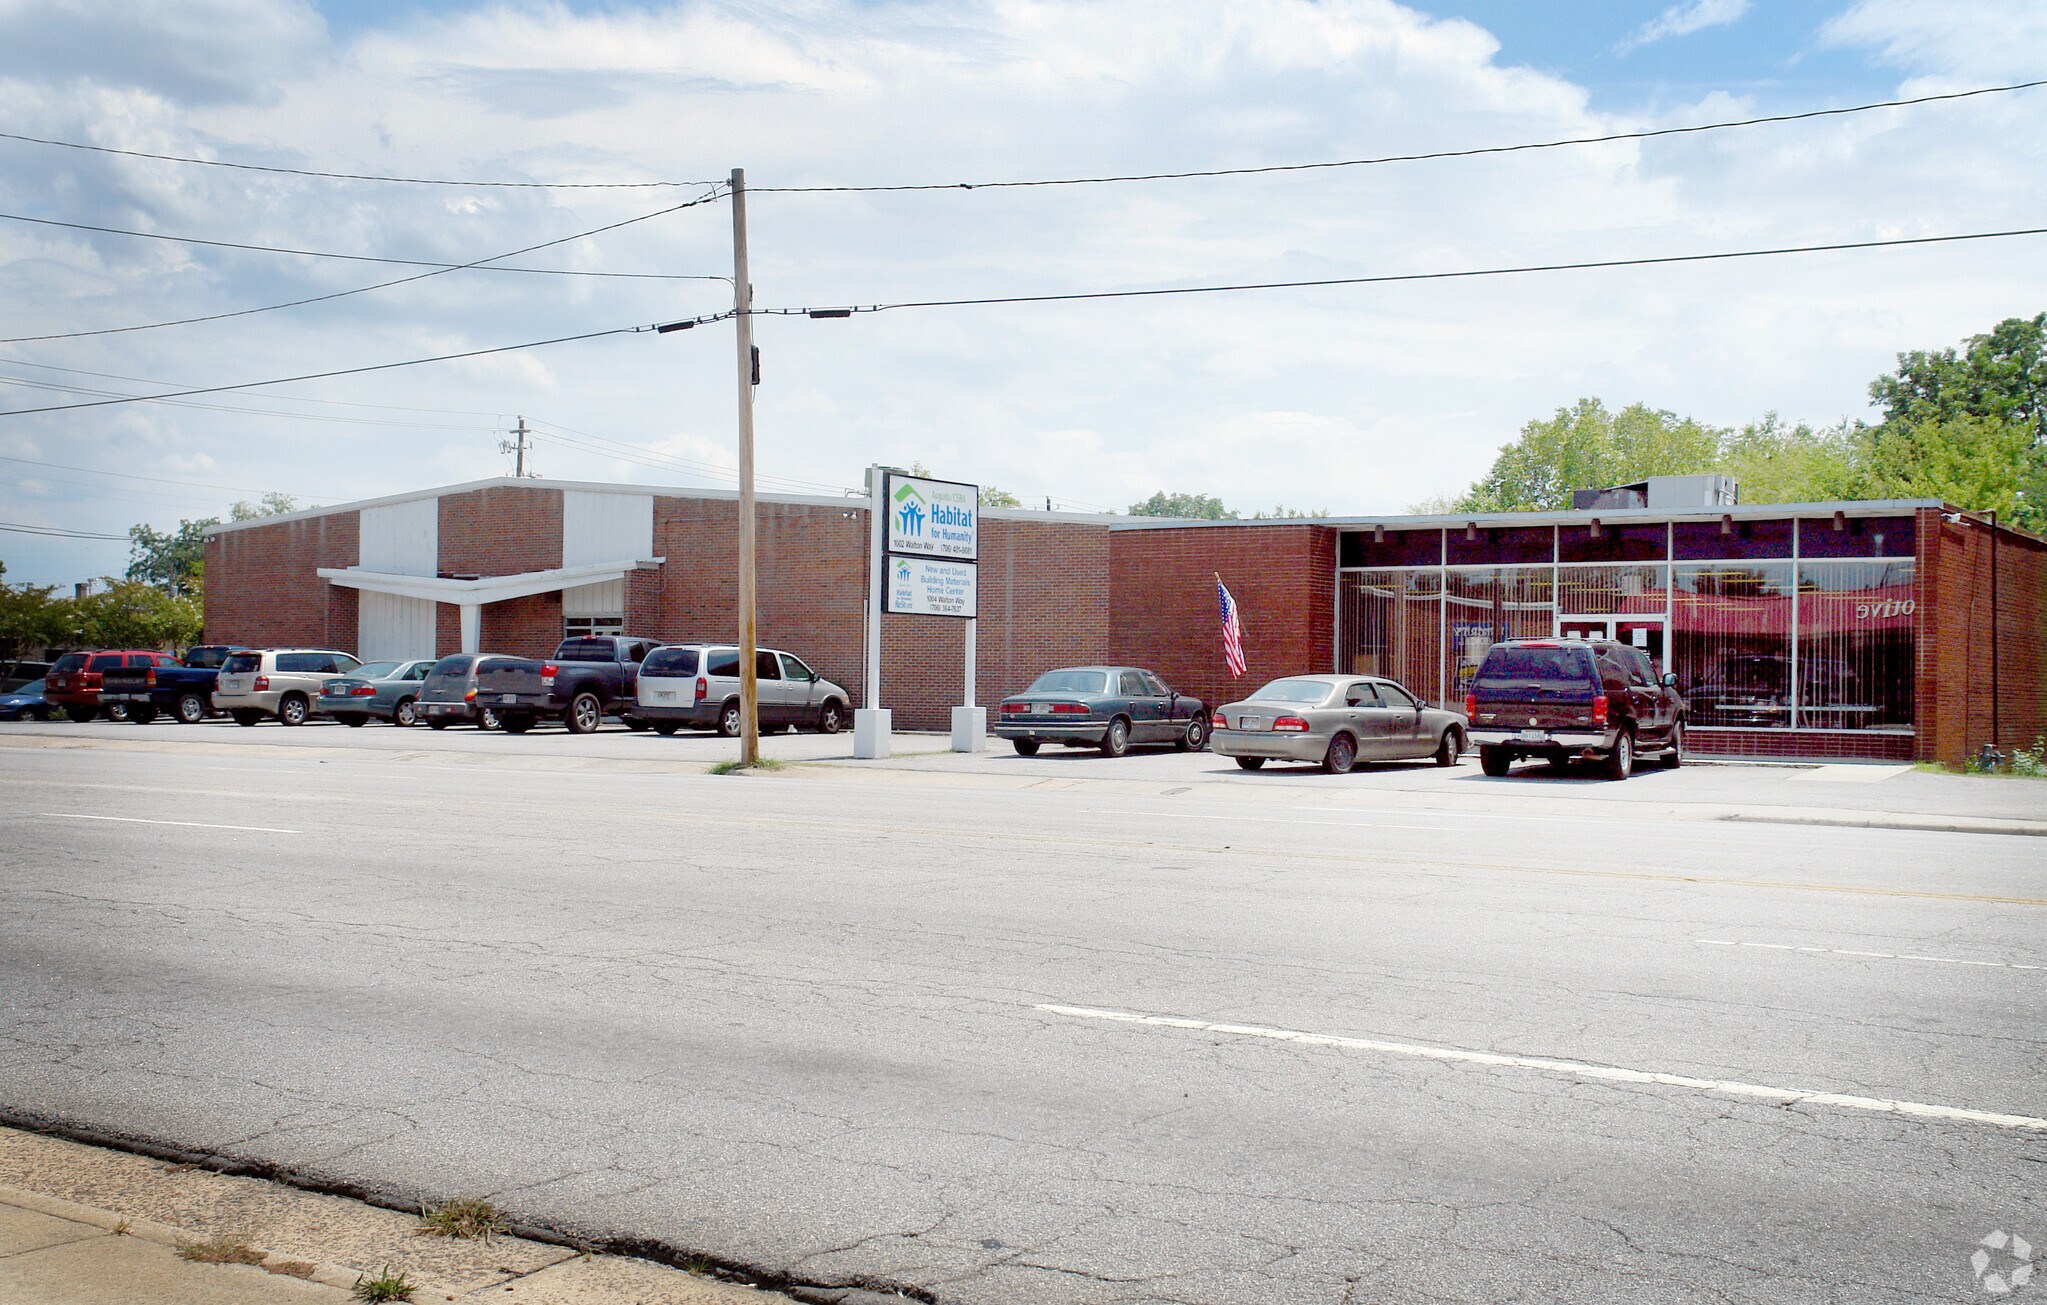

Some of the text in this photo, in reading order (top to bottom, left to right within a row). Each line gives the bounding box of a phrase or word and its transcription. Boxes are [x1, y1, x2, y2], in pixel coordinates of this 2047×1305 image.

[931, 503, 972, 527] Habitat
[931, 527, 972, 545] for Humanity
[894, 539, 905, 548] 1002
[905, 540, 922, 549] Walton
[923, 541, 934, 551] Way
[925, 564, 967, 576] New and Used
[920, 575, 971, 586] Building Materials
[927, 586, 964, 596] Home Center
[937, 596, 955, 604] Walton
[955, 597, 965, 606] Way
